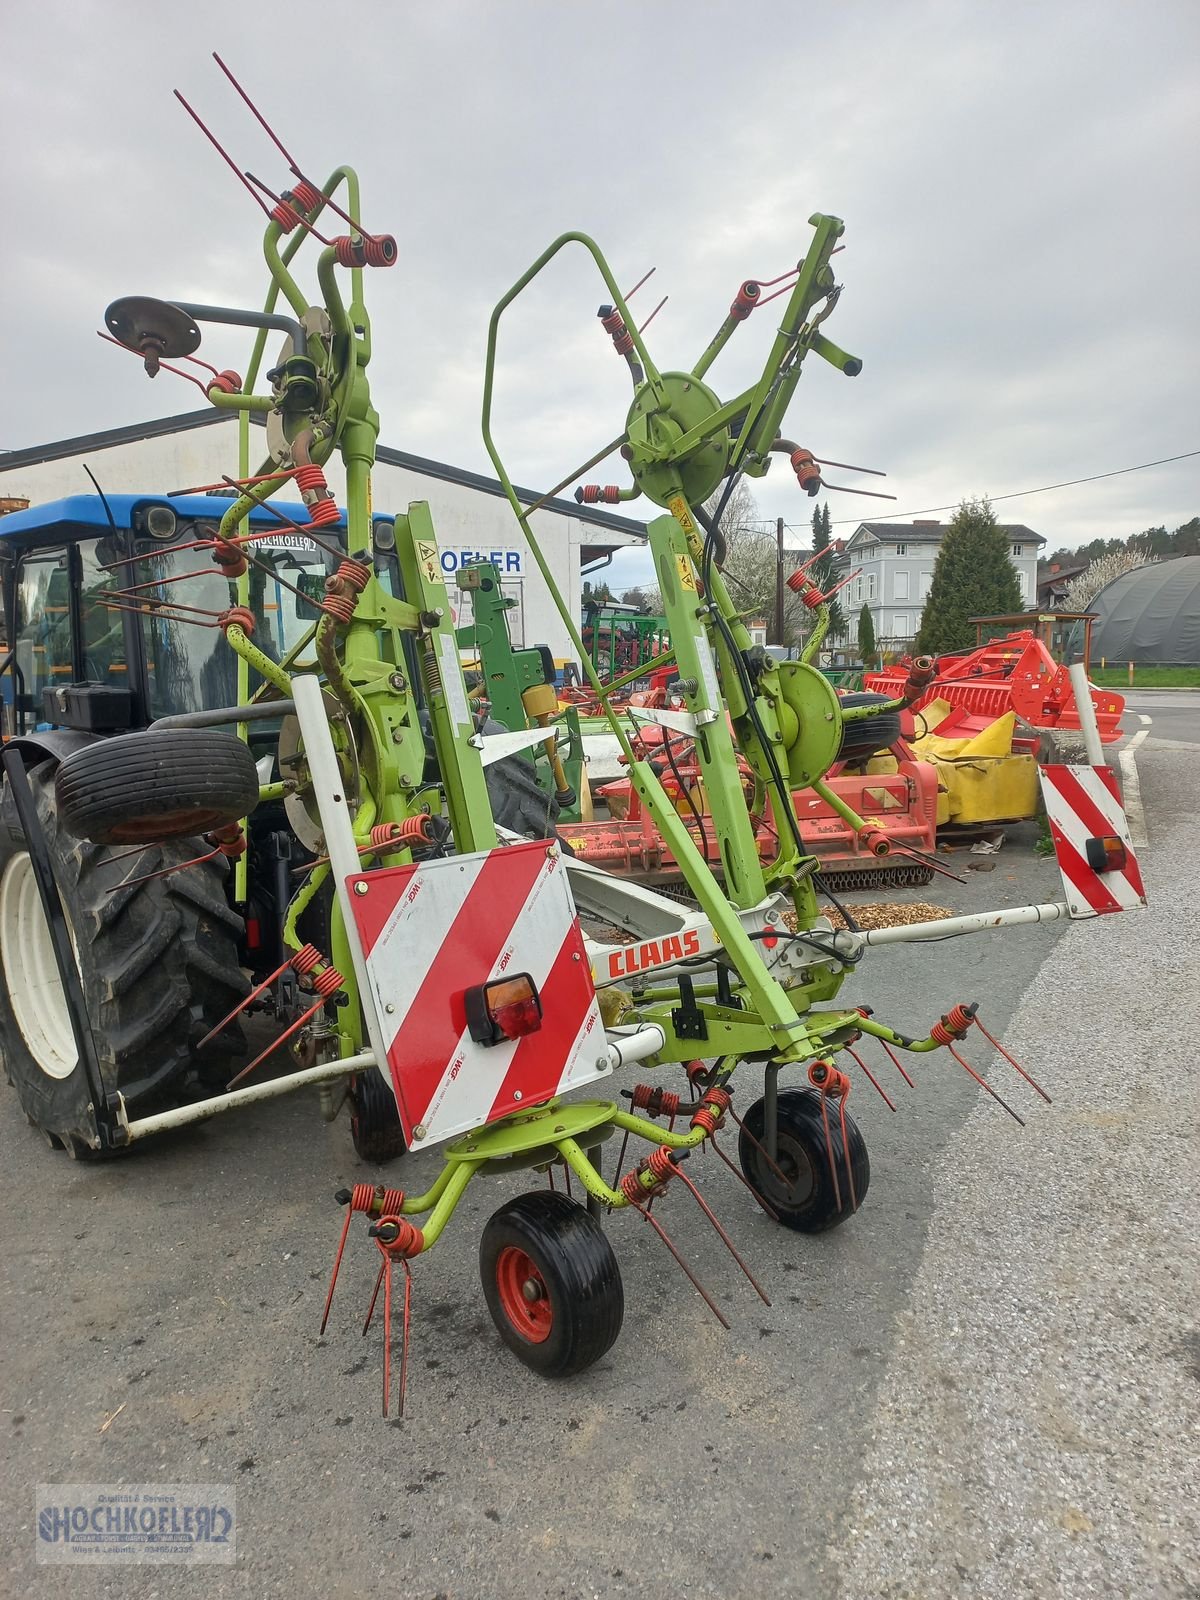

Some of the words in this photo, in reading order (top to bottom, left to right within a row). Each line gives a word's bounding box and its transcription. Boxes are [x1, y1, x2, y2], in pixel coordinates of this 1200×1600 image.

[254, 536, 310, 551] HOCHKOFLER
[440, 551, 521, 572] OFER
[408, 884, 420, 903] WGF
[500, 952, 511, 971] WGF
[609, 930, 700, 978] CLAAS
[586, 1015, 596, 1034] WGF
[450, 1059, 462, 1080] WGF
